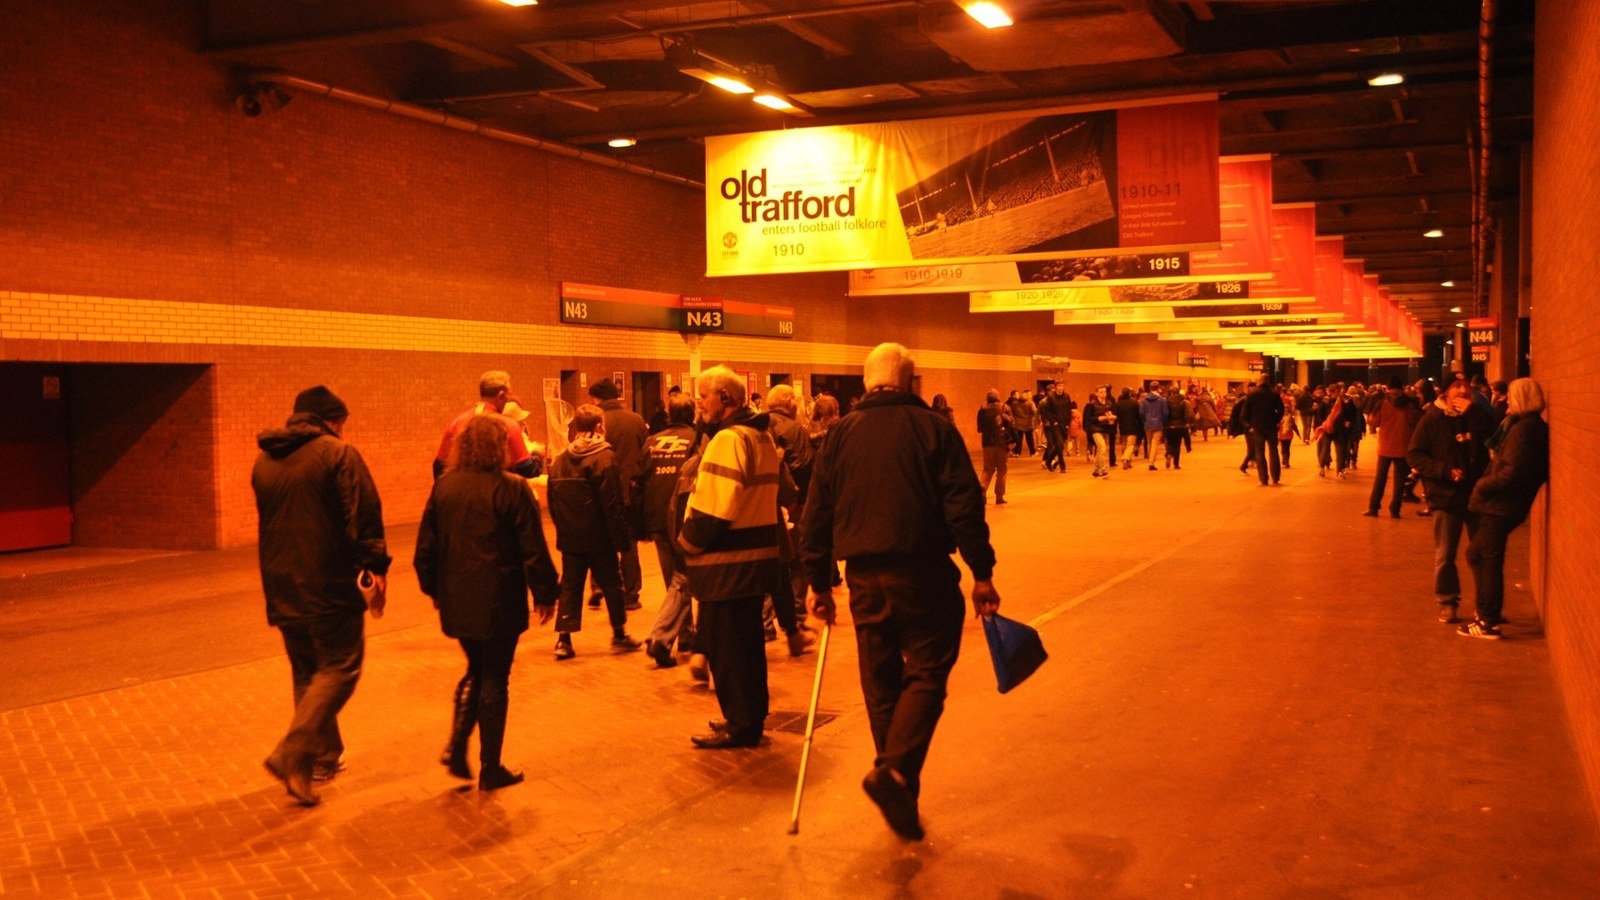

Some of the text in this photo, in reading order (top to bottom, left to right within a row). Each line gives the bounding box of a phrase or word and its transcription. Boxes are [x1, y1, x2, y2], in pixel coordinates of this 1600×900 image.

[720, 168, 767, 200] old
[1121, 182, 1181, 199] 1910-11
[739, 186, 855, 223] trafford
[762, 218, 887, 236] enters football folklore
[773, 243, 805, 256] 1910
[1149, 257, 1180, 271] 1915
[1215, 283, 1241, 294] 1926
[565, 301, 588, 320] N43
[687, 311, 722, 328] N43
[779, 320, 793, 335] N43
[1470, 330, 1493, 343] N44
[1472, 353, 1487, 361] N45
